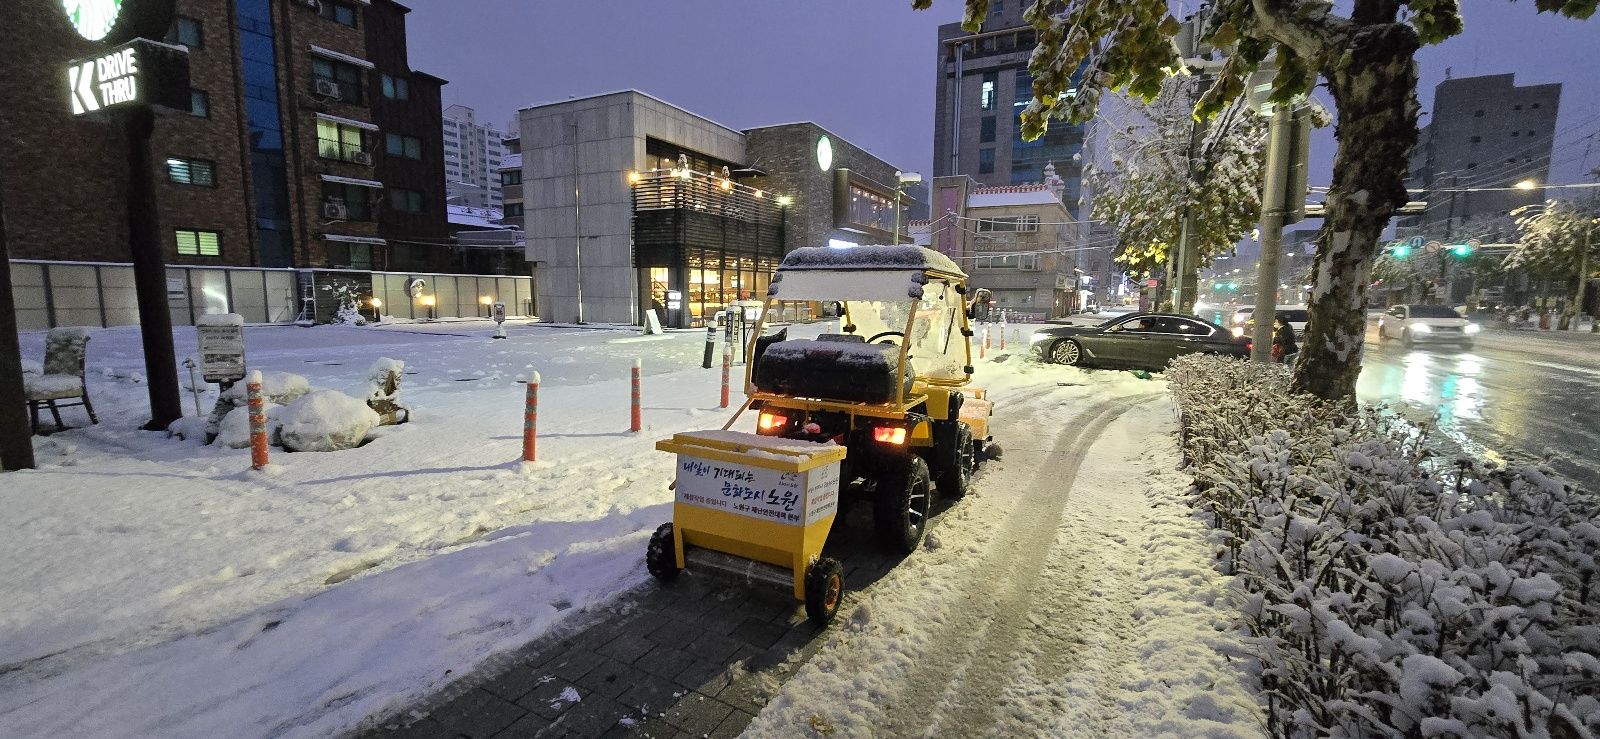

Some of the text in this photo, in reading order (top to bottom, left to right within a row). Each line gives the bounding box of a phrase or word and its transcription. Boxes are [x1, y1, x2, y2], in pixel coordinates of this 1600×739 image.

[97, 48, 137, 81] DRIVE
[100, 75, 136, 106] THRU
[683, 461, 756, 483] 내일이 기대되는
[721, 481, 765, 501] 문화도시
[766, 488, 799, 511] 노원
